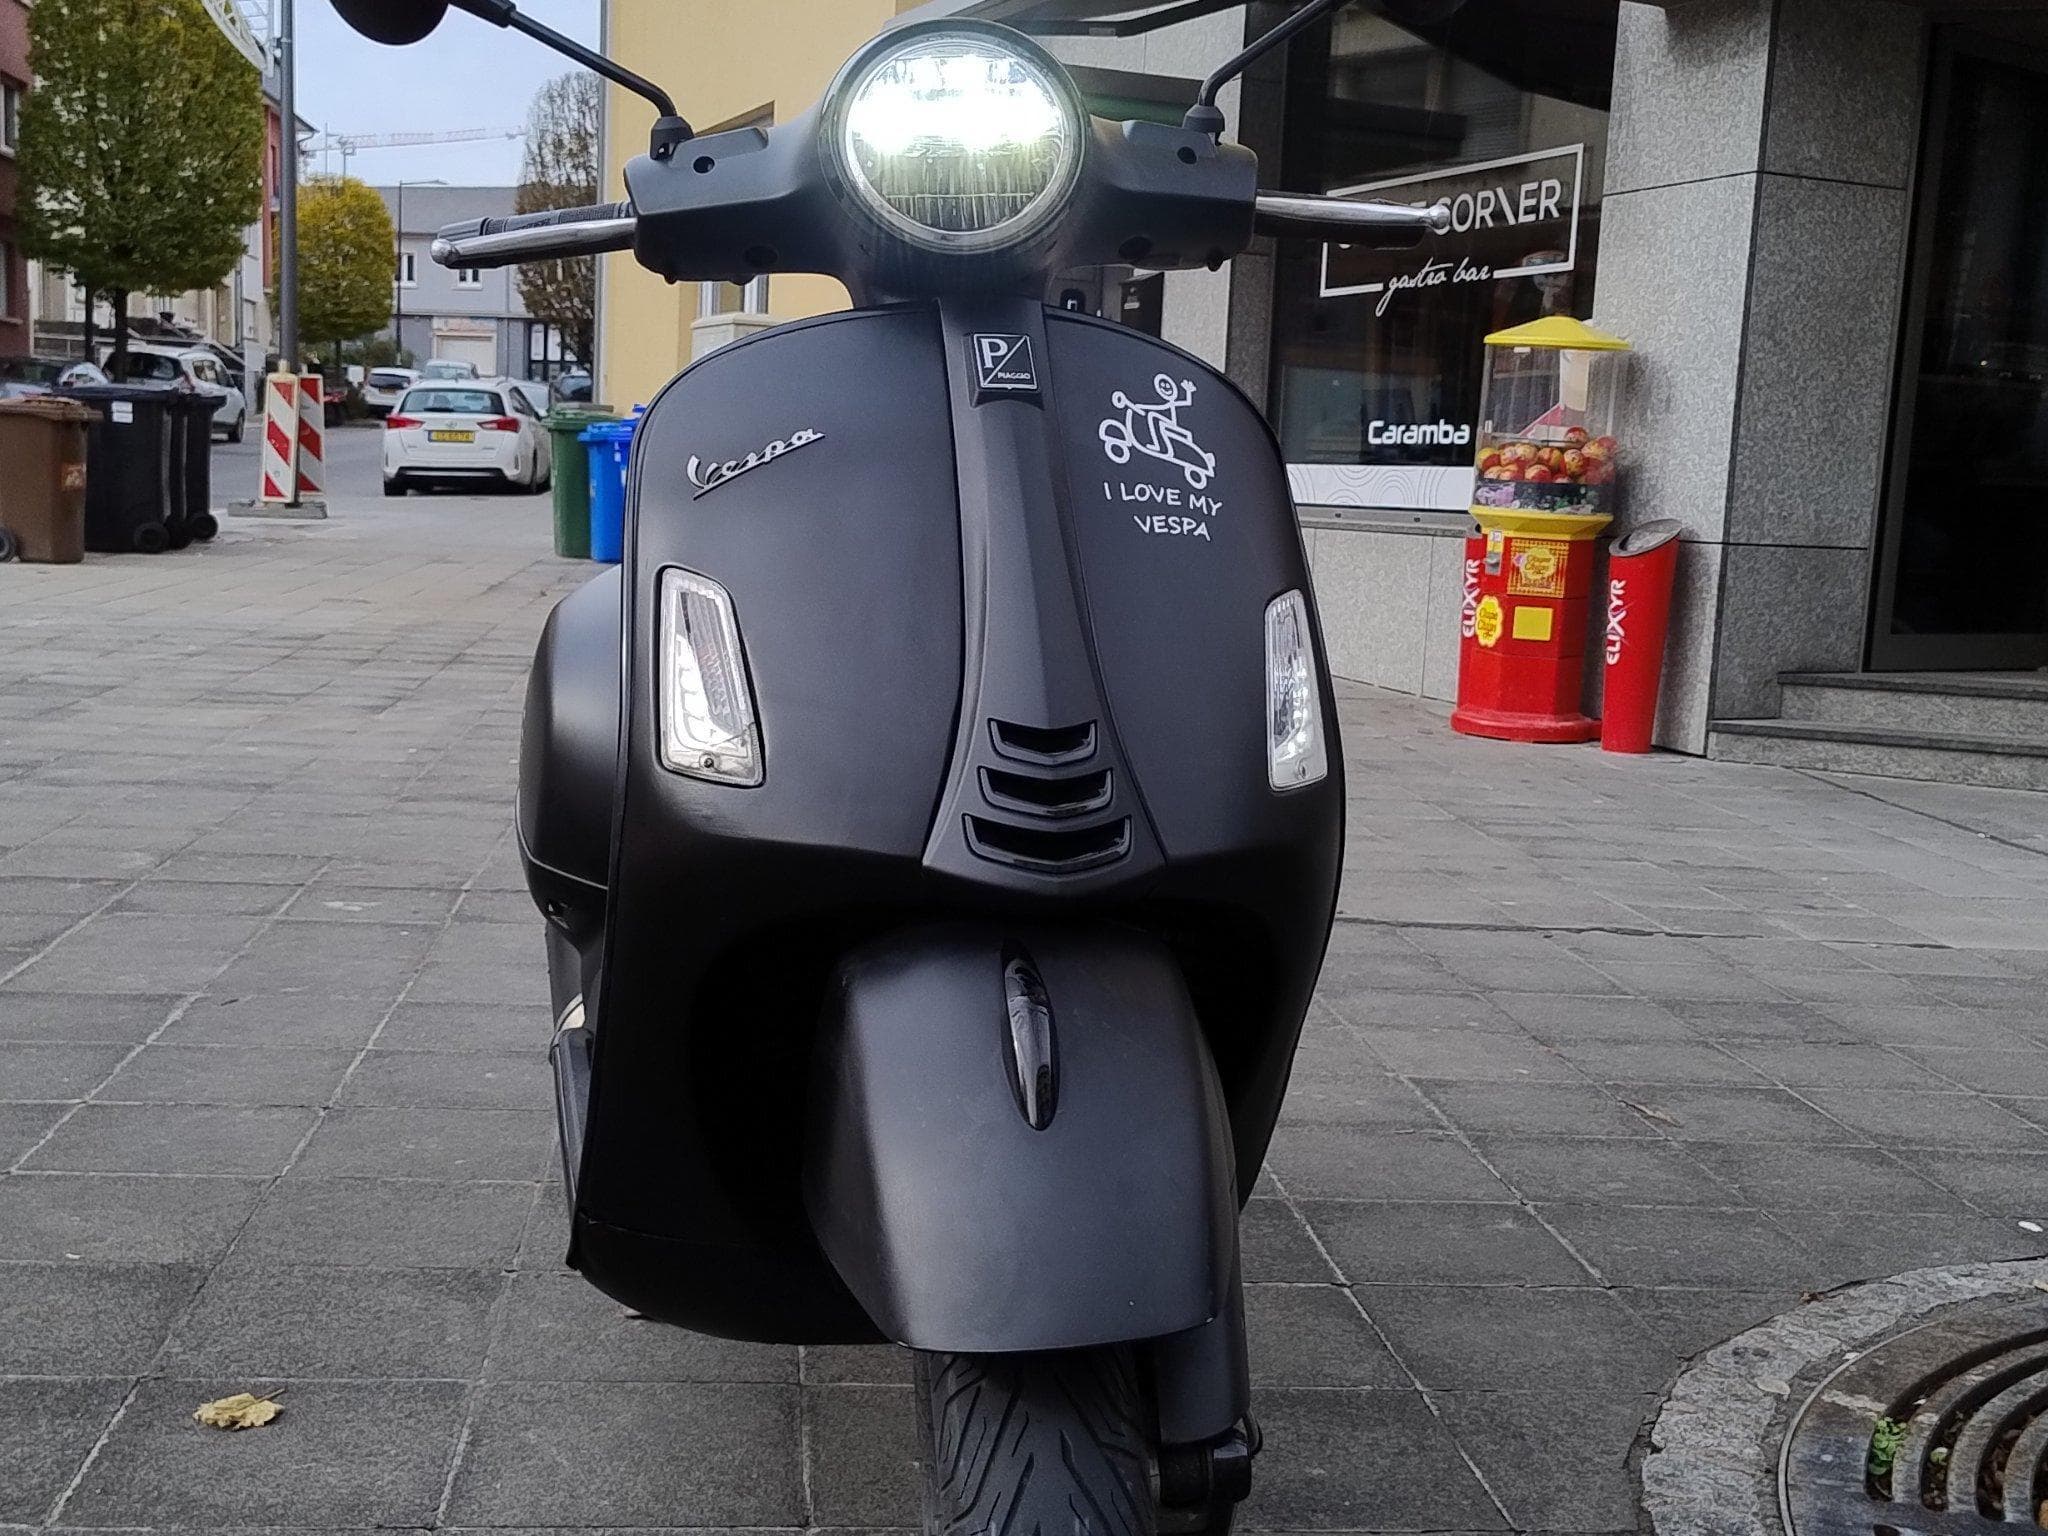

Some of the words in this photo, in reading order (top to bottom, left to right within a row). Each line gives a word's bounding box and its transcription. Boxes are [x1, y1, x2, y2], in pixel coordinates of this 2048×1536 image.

[1375, 257, 1453, 318] gastro
[1452, 256, 1491, 283] bar
[980, 338, 1008, 369] P
[997, 372, 1031, 380] PIAGGIO
[1368, 418, 1470, 445] Caramba
[686, 428, 826, 501] Vespa
[1103, 482, 1112, 500] I
[1120, 482, 1182, 506] LOVE
[1189, 494, 1223, 516] MY
[1133, 515, 1211, 541] VESPA
[1462, 558, 1482, 638] ELIXYR
[1606, 579, 1627, 665] ELIXYR
